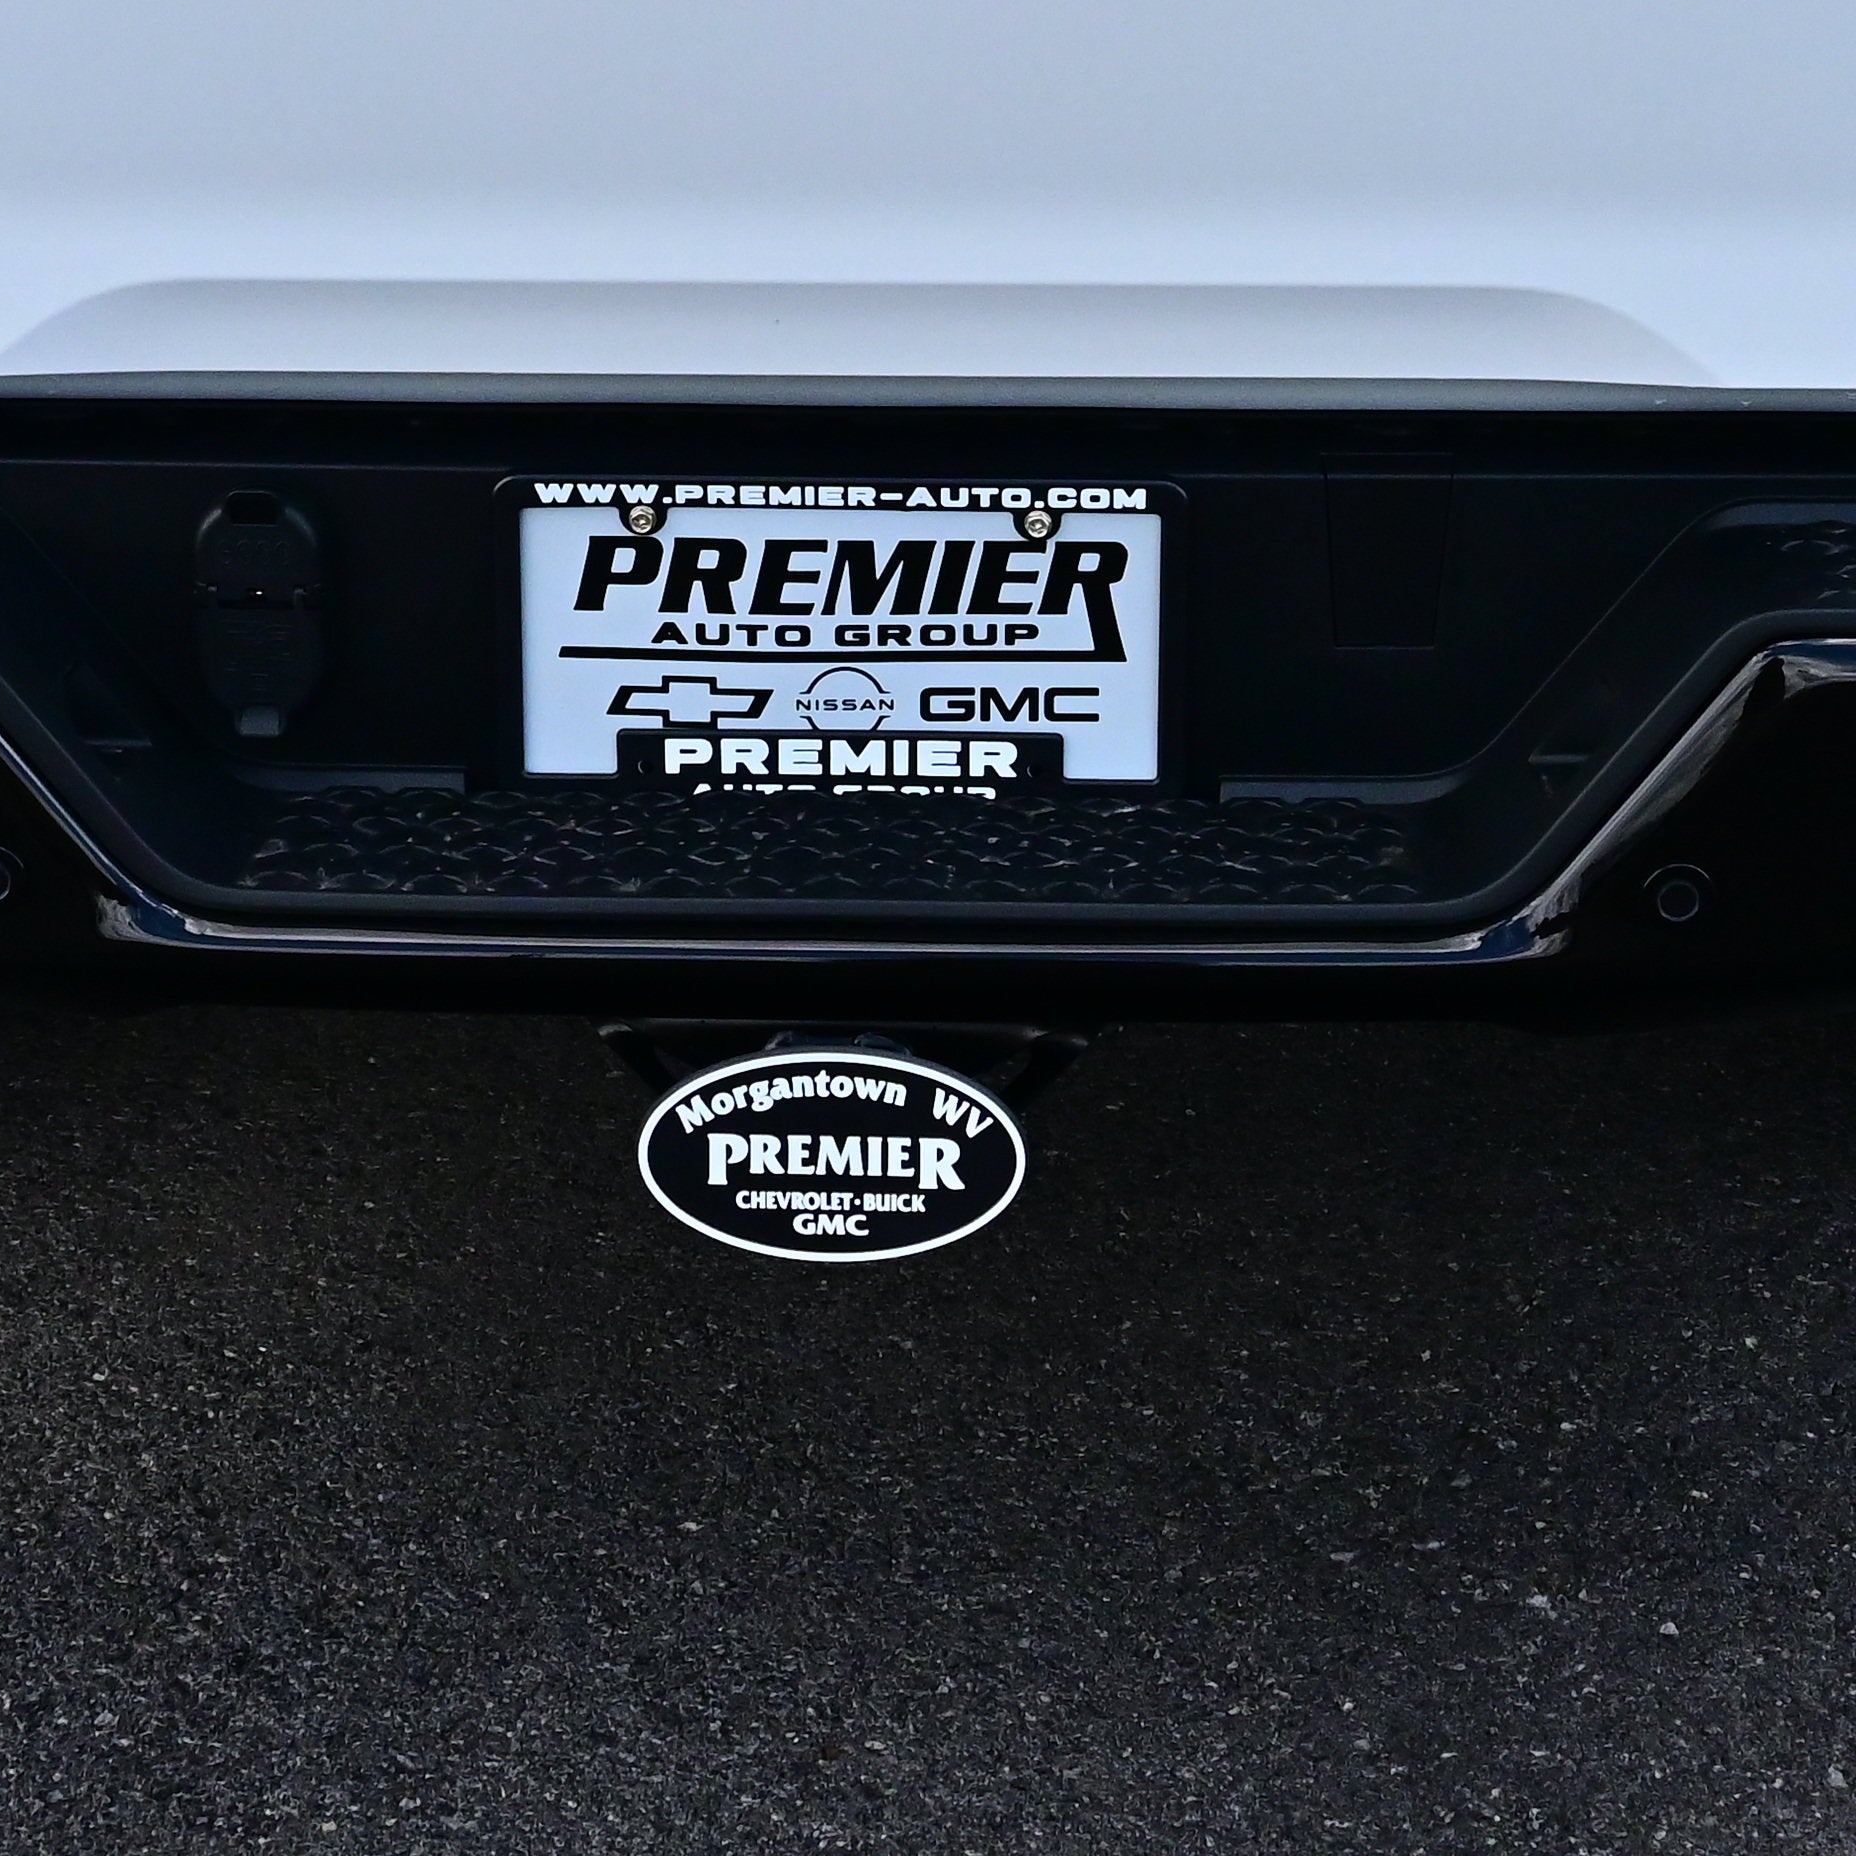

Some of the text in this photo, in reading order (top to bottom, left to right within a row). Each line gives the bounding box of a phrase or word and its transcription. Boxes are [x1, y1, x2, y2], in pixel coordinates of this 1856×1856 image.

[535, 483, 1147, 510] WWW.PREMIER-AUTO.COM
[573, 535, 1130, 662] PREMIER
[650, 621, 1040, 647] AUTO GROUP
[795, 697, 895, 712] NISSAN
[919, 686, 1100, 723] GMC
[664, 737, 1018, 778] PREMIER
[674, 1069, 994, 1140] Morgantown WV
[707, 1133, 965, 1191] PREMIER
[792, 1213, 870, 1237] GMC
